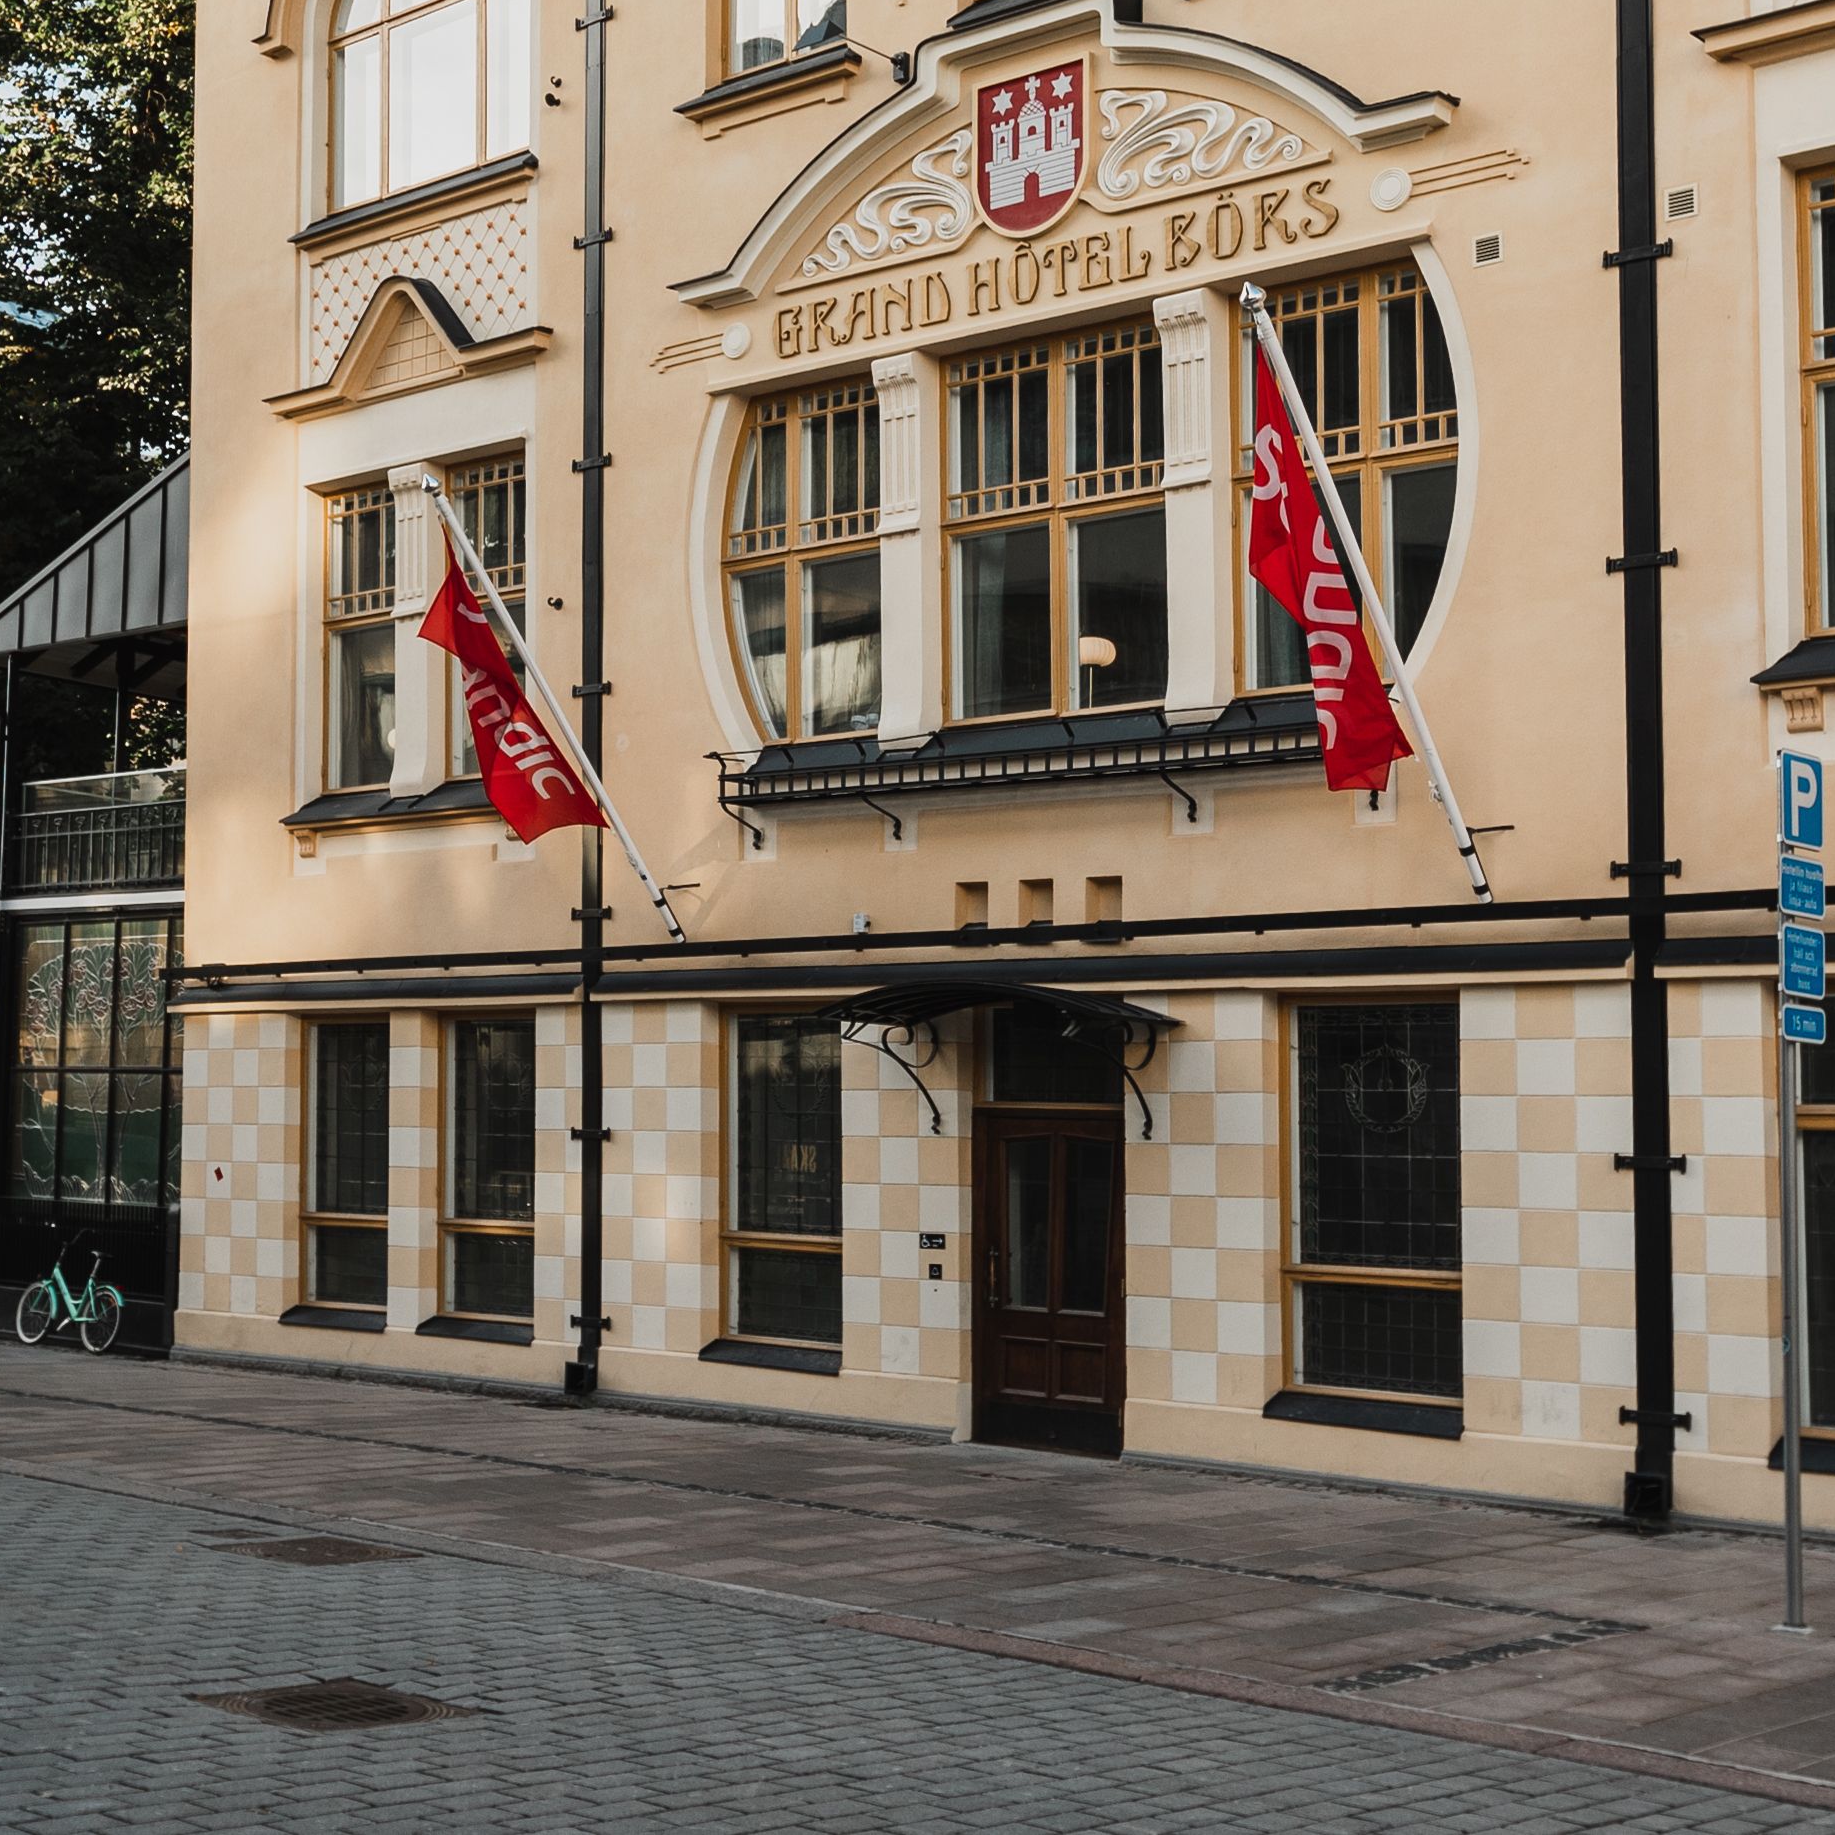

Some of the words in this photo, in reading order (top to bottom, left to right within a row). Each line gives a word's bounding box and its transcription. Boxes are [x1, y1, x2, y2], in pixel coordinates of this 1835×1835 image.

[772, 270, 952, 359] GRAND
[967, 225, 1152, 317] HÔTEL
[1163, 178, 1340, 272] BÖRS
[1790, 759, 1818, 838] P
[1792, 1014, 1802, 1031] 15
[1802, 1017, 1817, 1033] min
